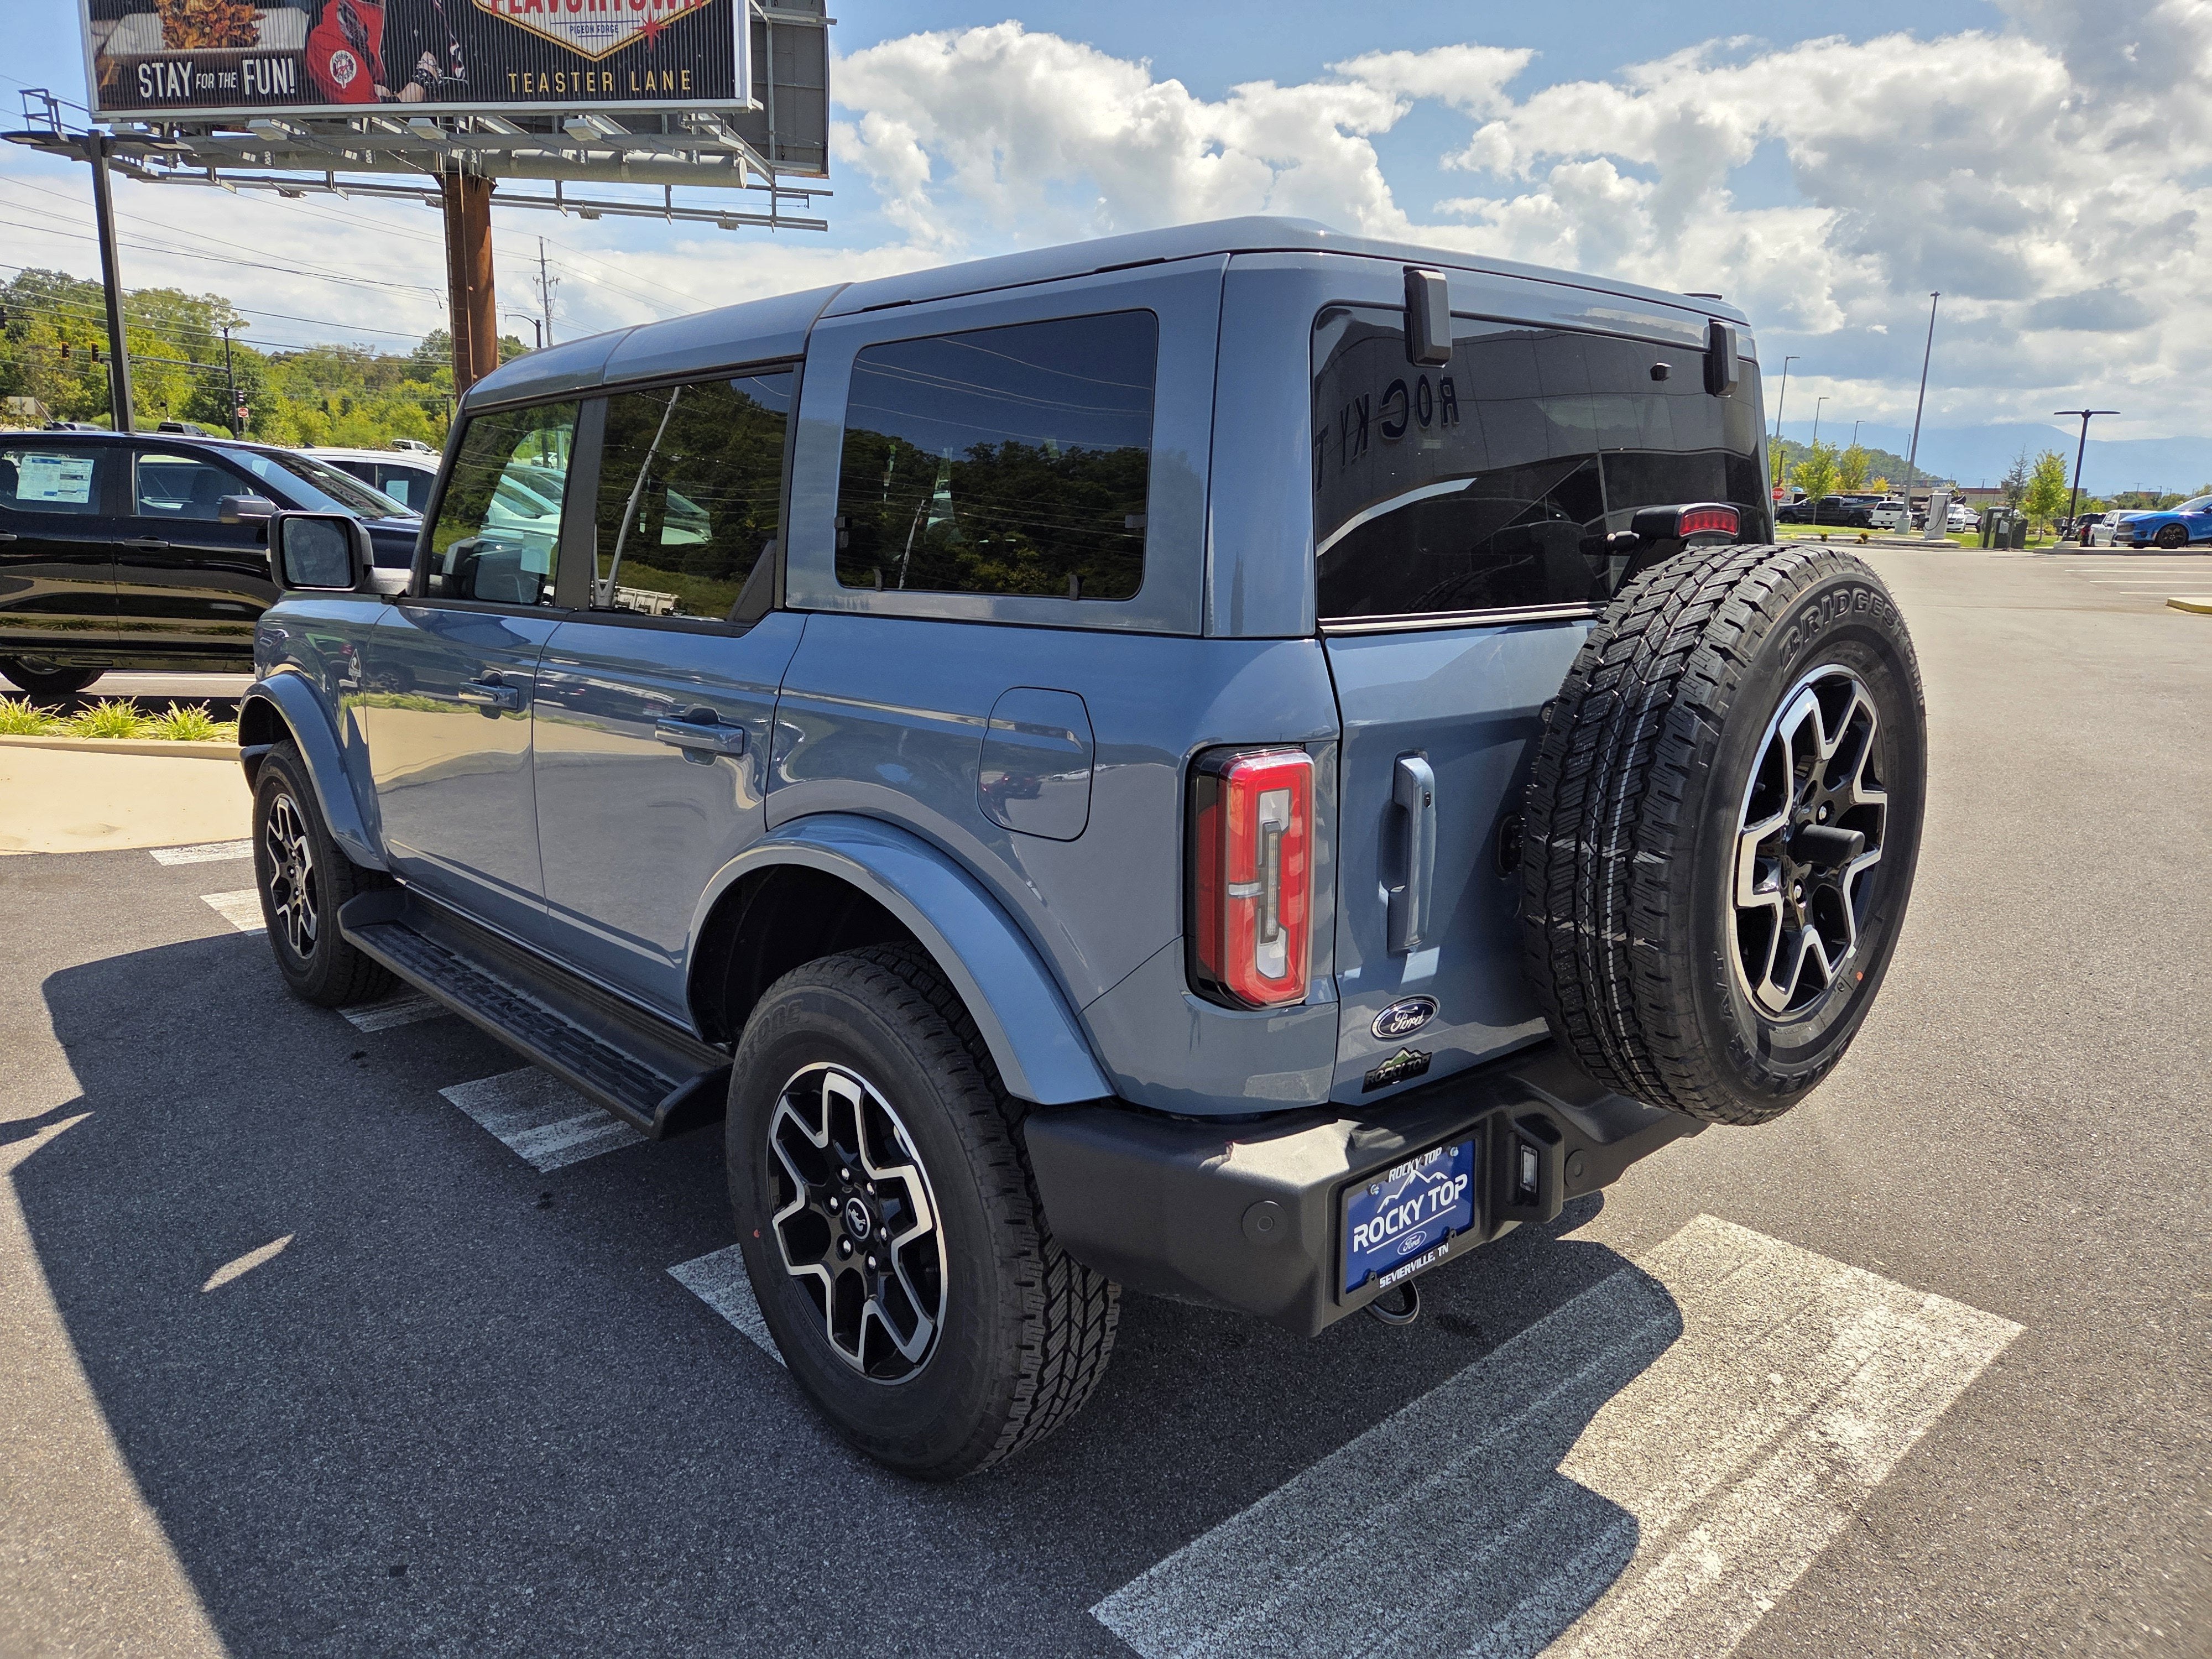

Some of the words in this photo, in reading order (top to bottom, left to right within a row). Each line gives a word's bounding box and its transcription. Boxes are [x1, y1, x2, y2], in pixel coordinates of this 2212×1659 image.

[569, 25, 594, 34] PIGEON
[597, 24, 619, 33] FORGE
[138, 61, 192, 97] STAY
[196, 73, 214, 89] FOR
[218, 72, 237, 88] THE
[243, 58, 295, 95] FUN!
[508, 72, 613, 93] TEASTER
[632, 70, 691, 91] LANE
[1390, 1002, 1425, 1032] Ford
[1366, 1062, 1406, 1086] ROCKY
[1407, 1054, 1432, 1070] TOP
[1389, 1157, 1422, 1183] ROCKY
[1424, 1147, 1442, 1165] TOP
[1353, 1194, 1425, 1253] ROCKY
[1428, 1173, 1468, 1212] TOP
[1402, 1234, 1422, 1251] Ford
[1379, 1251, 1436, 1288] SEVIERVILLE,
[1438, 1243, 1449, 1257] TN
